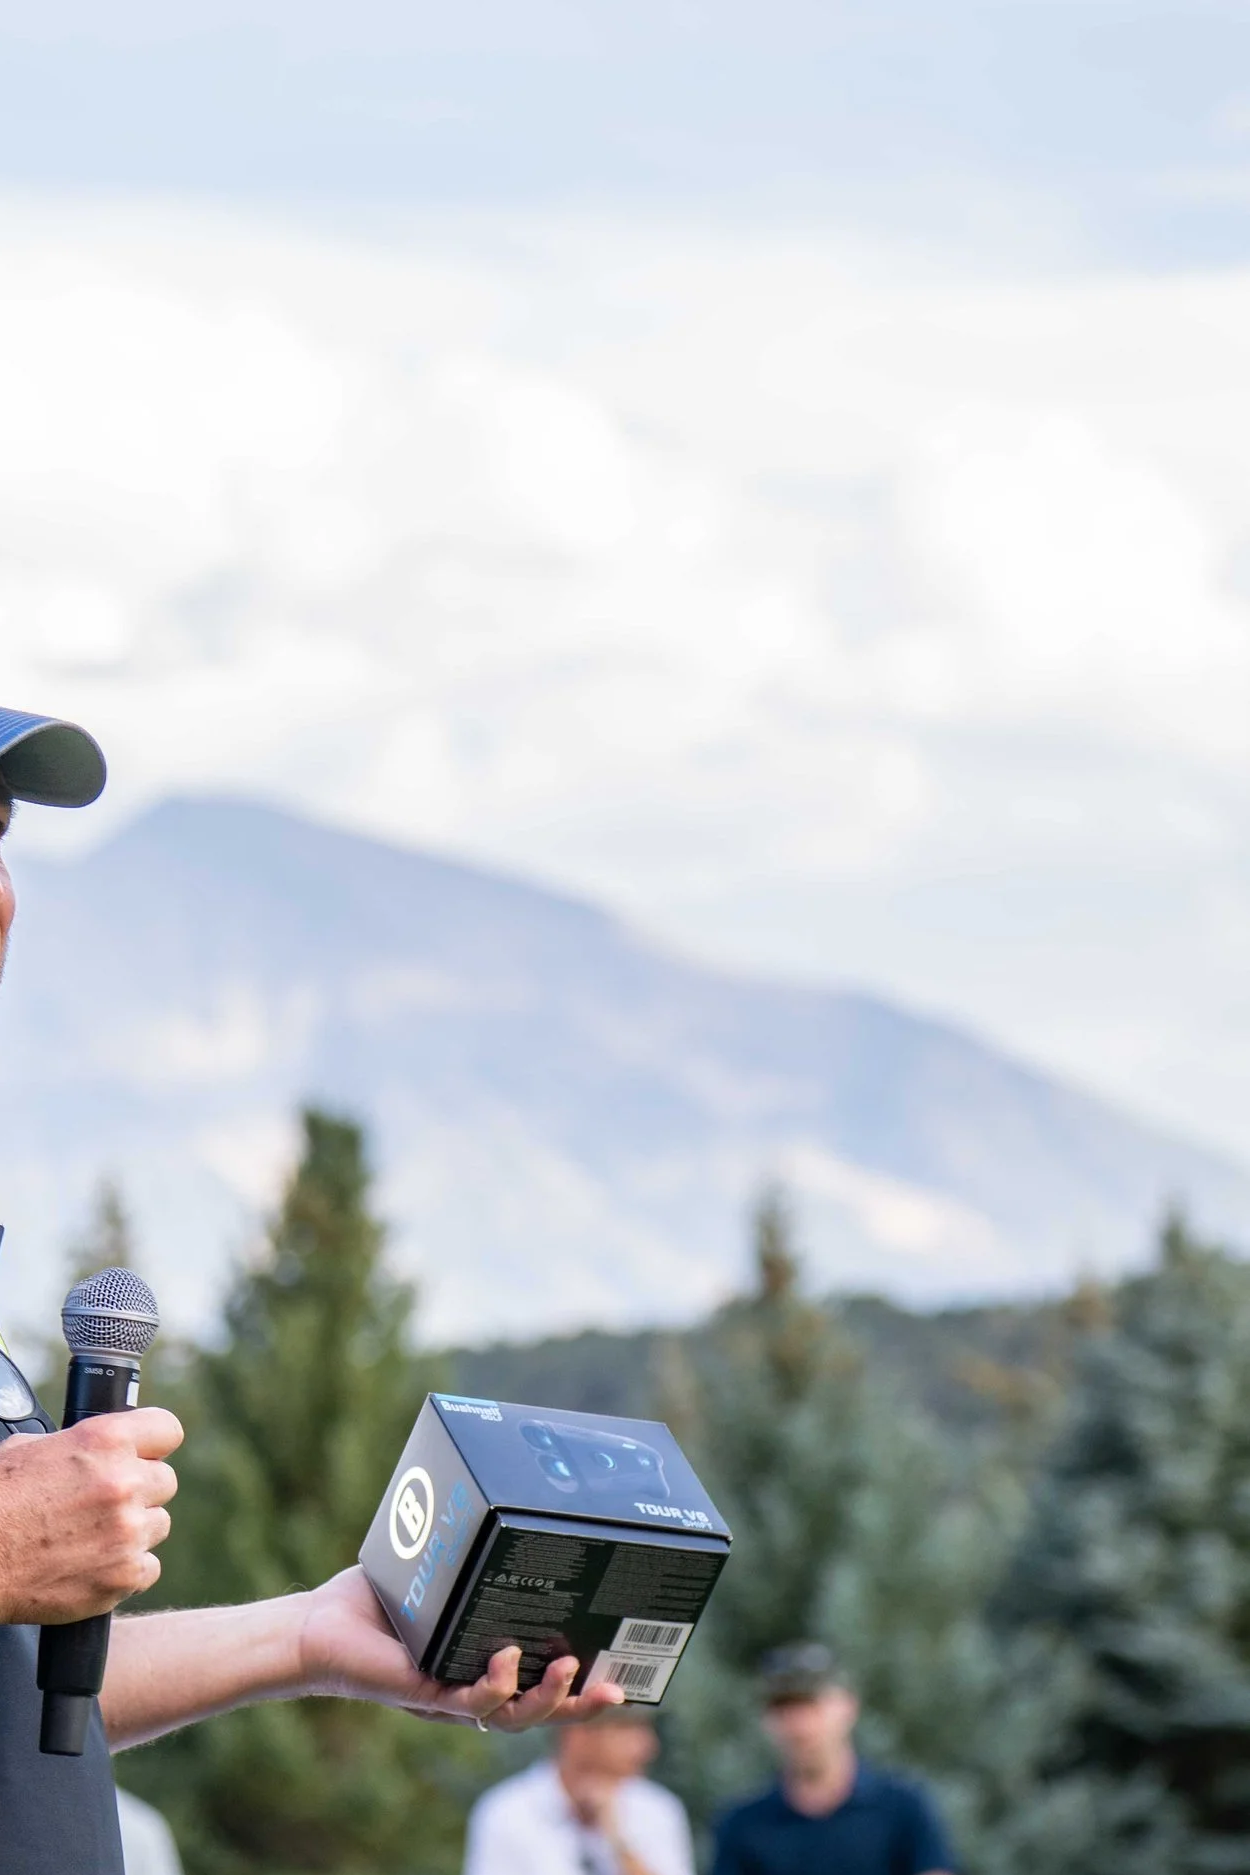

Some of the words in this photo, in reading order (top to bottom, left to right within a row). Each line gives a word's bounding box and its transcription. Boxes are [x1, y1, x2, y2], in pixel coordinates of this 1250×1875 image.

[84, 1367, 104, 1375] SM58
[440, 1400, 500, 1416] Bushnell
[633, 1502, 684, 1519] TOUR
[400, 1530, 446, 1624] TOUR
